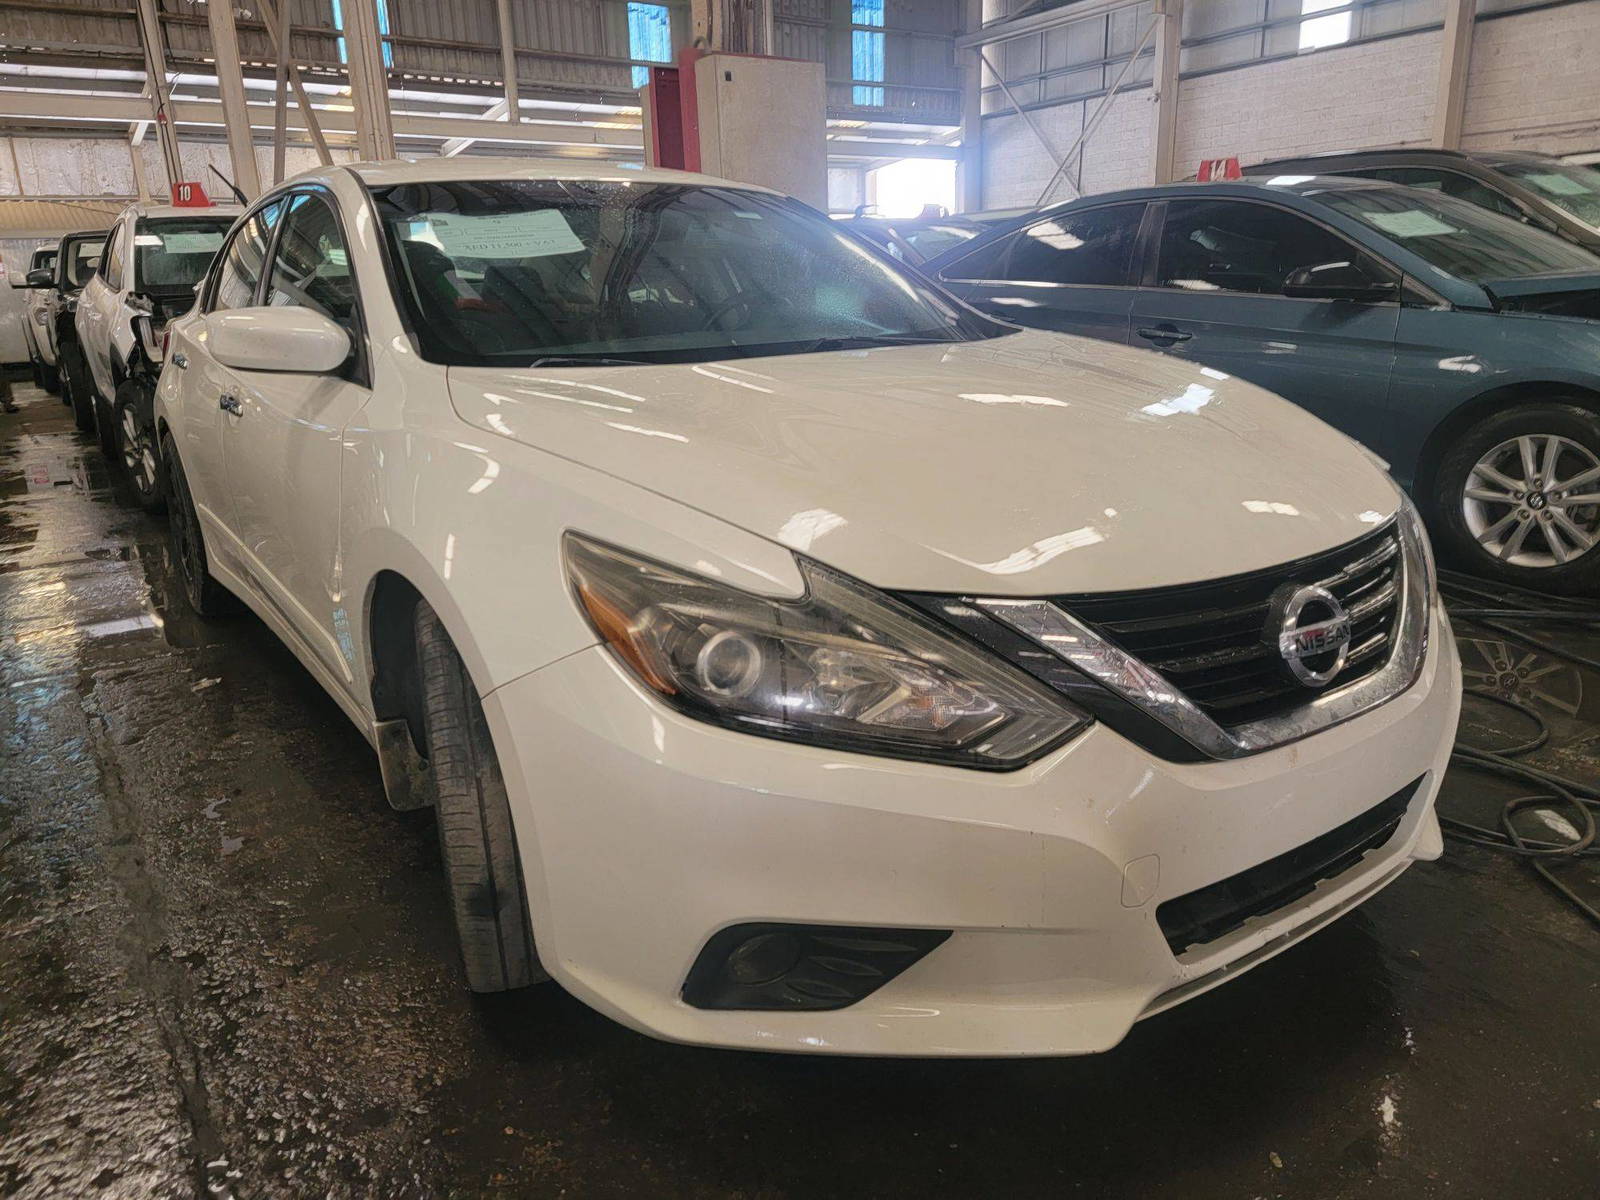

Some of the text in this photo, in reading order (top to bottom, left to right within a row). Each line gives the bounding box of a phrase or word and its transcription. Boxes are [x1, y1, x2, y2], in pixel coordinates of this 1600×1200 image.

[1210, 159, 1227, 181] 14
[179, 185, 191, 201] 10
[1295, 620, 1351, 653] NISSAN
